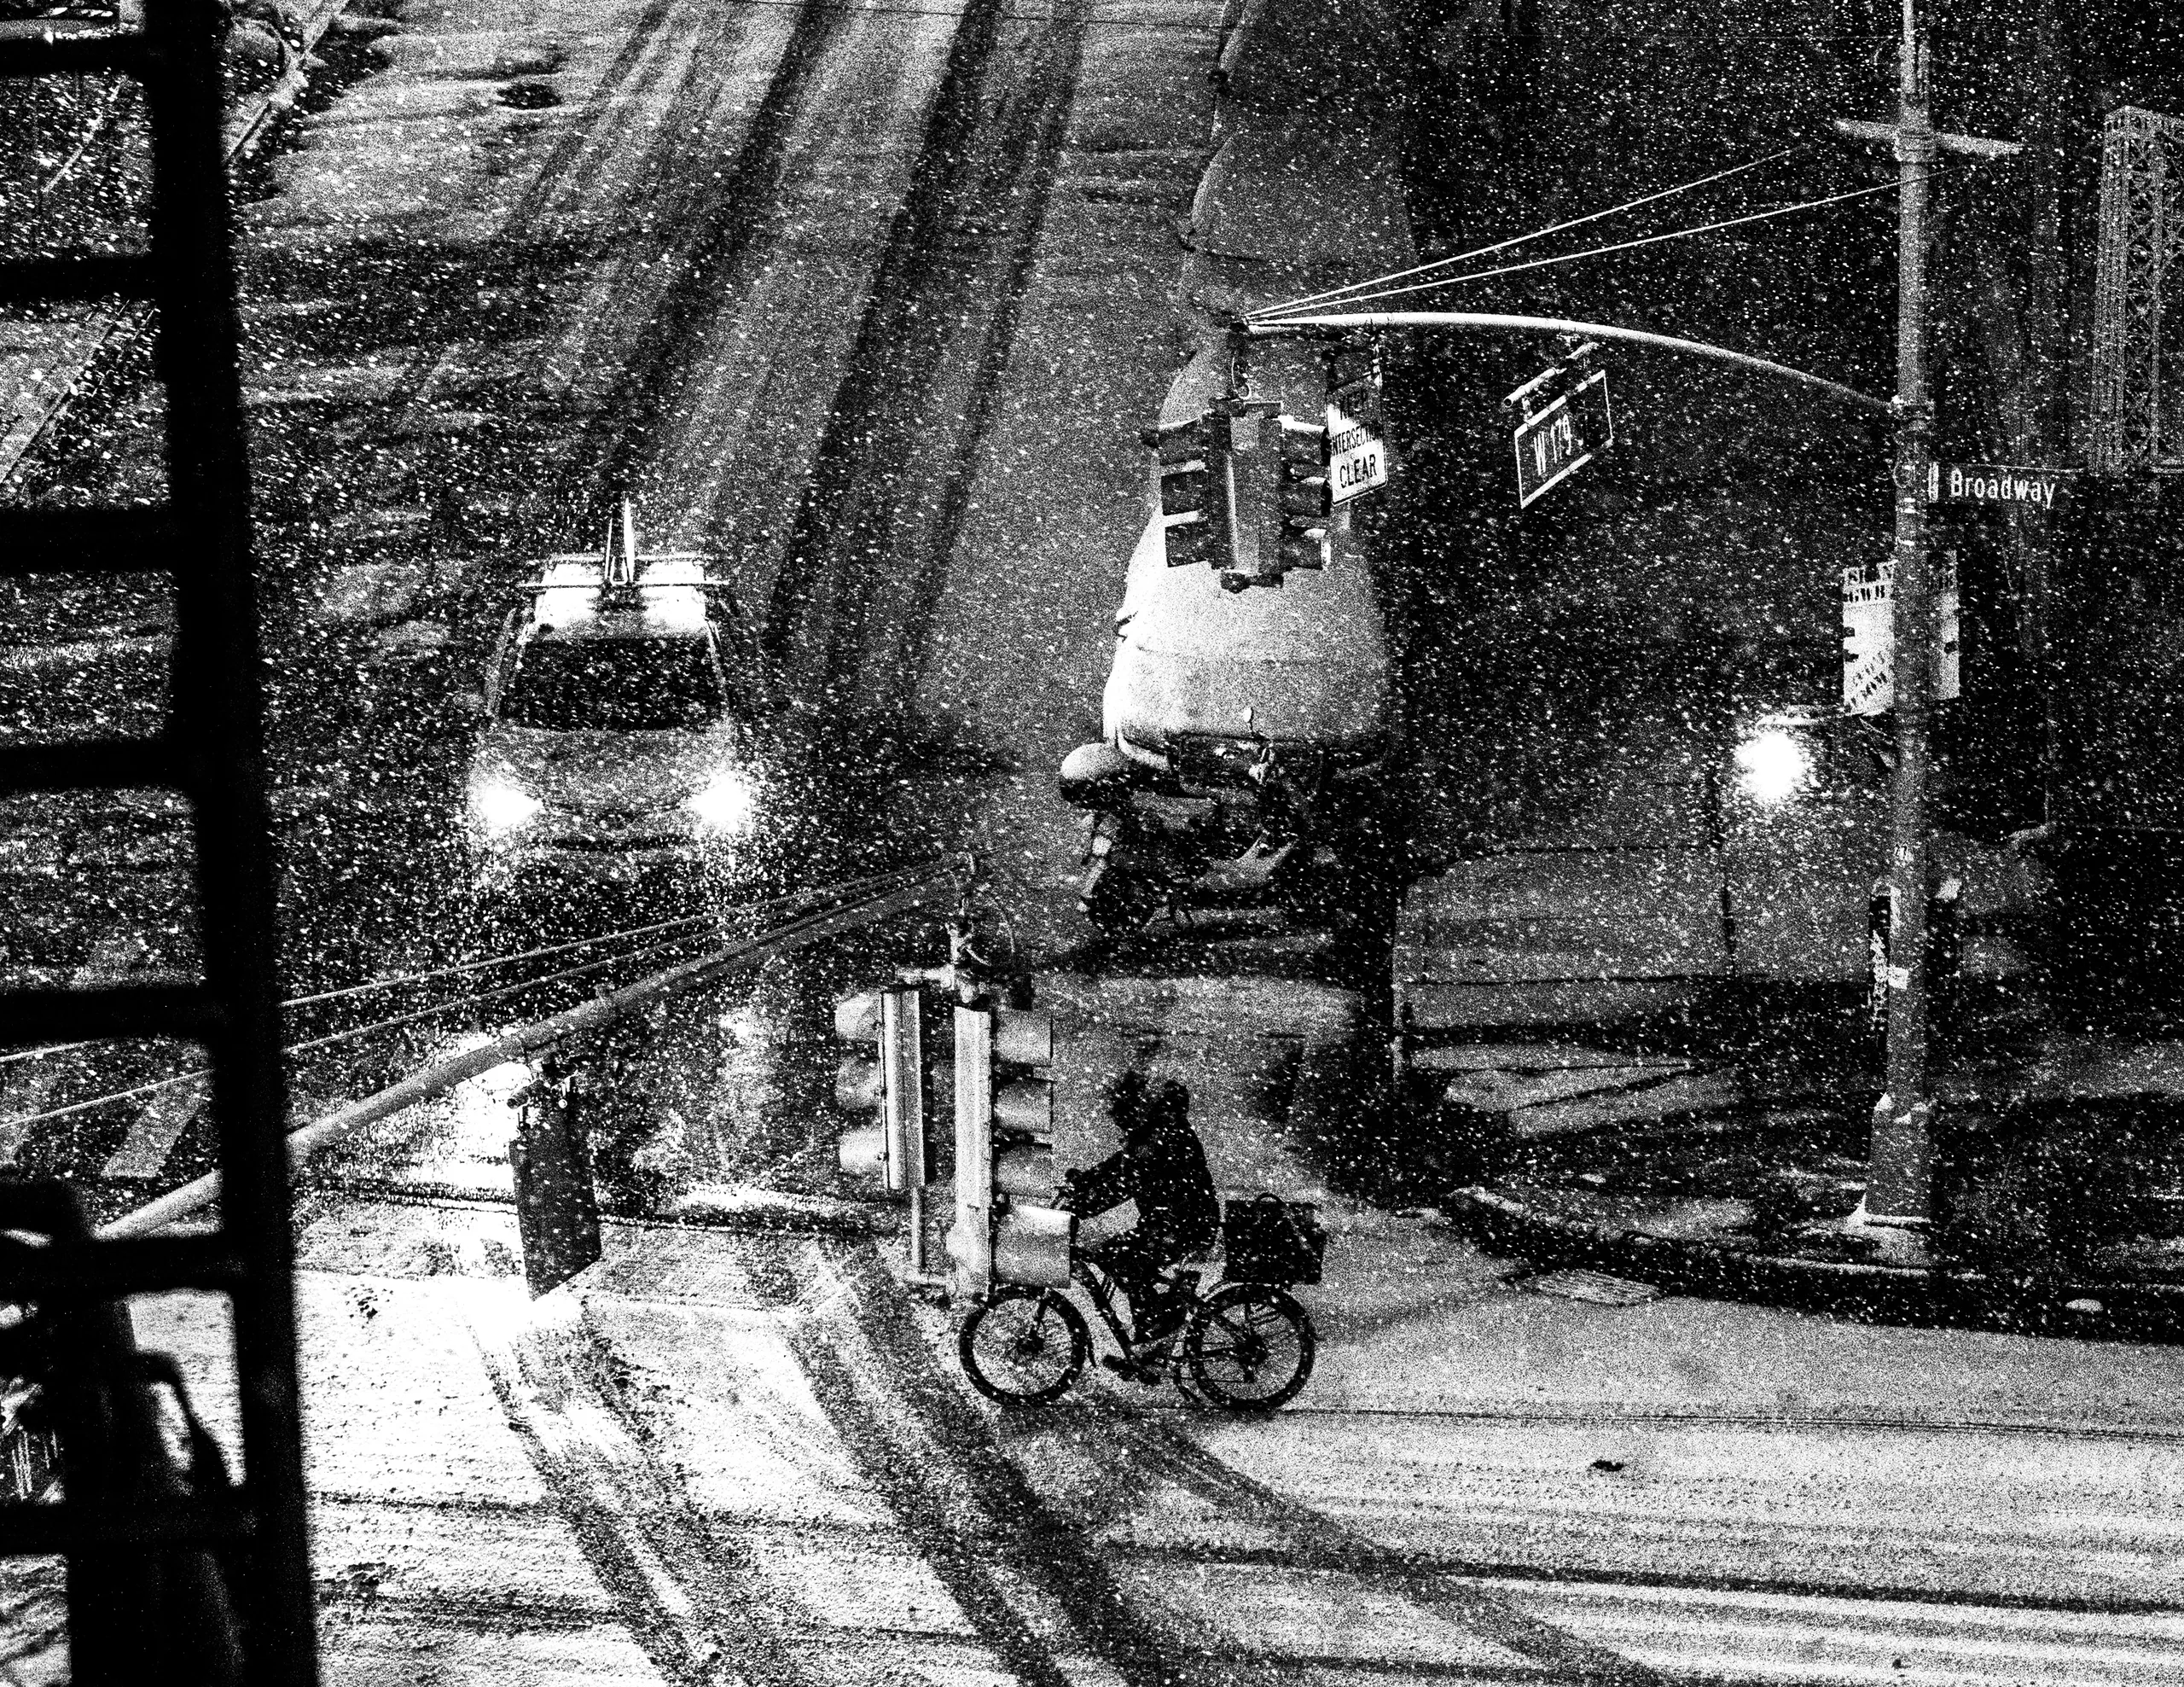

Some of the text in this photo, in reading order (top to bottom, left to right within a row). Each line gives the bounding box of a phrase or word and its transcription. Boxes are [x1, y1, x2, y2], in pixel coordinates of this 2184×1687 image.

[1339, 388, 1368, 421] KEEP
[1330, 422, 1383, 456] NTERSECTI
[1533, 413, 1573, 476] W 179
[1339, 454, 1377, 489] CLEAR
[1950, 468, 2056, 509] Broadway
